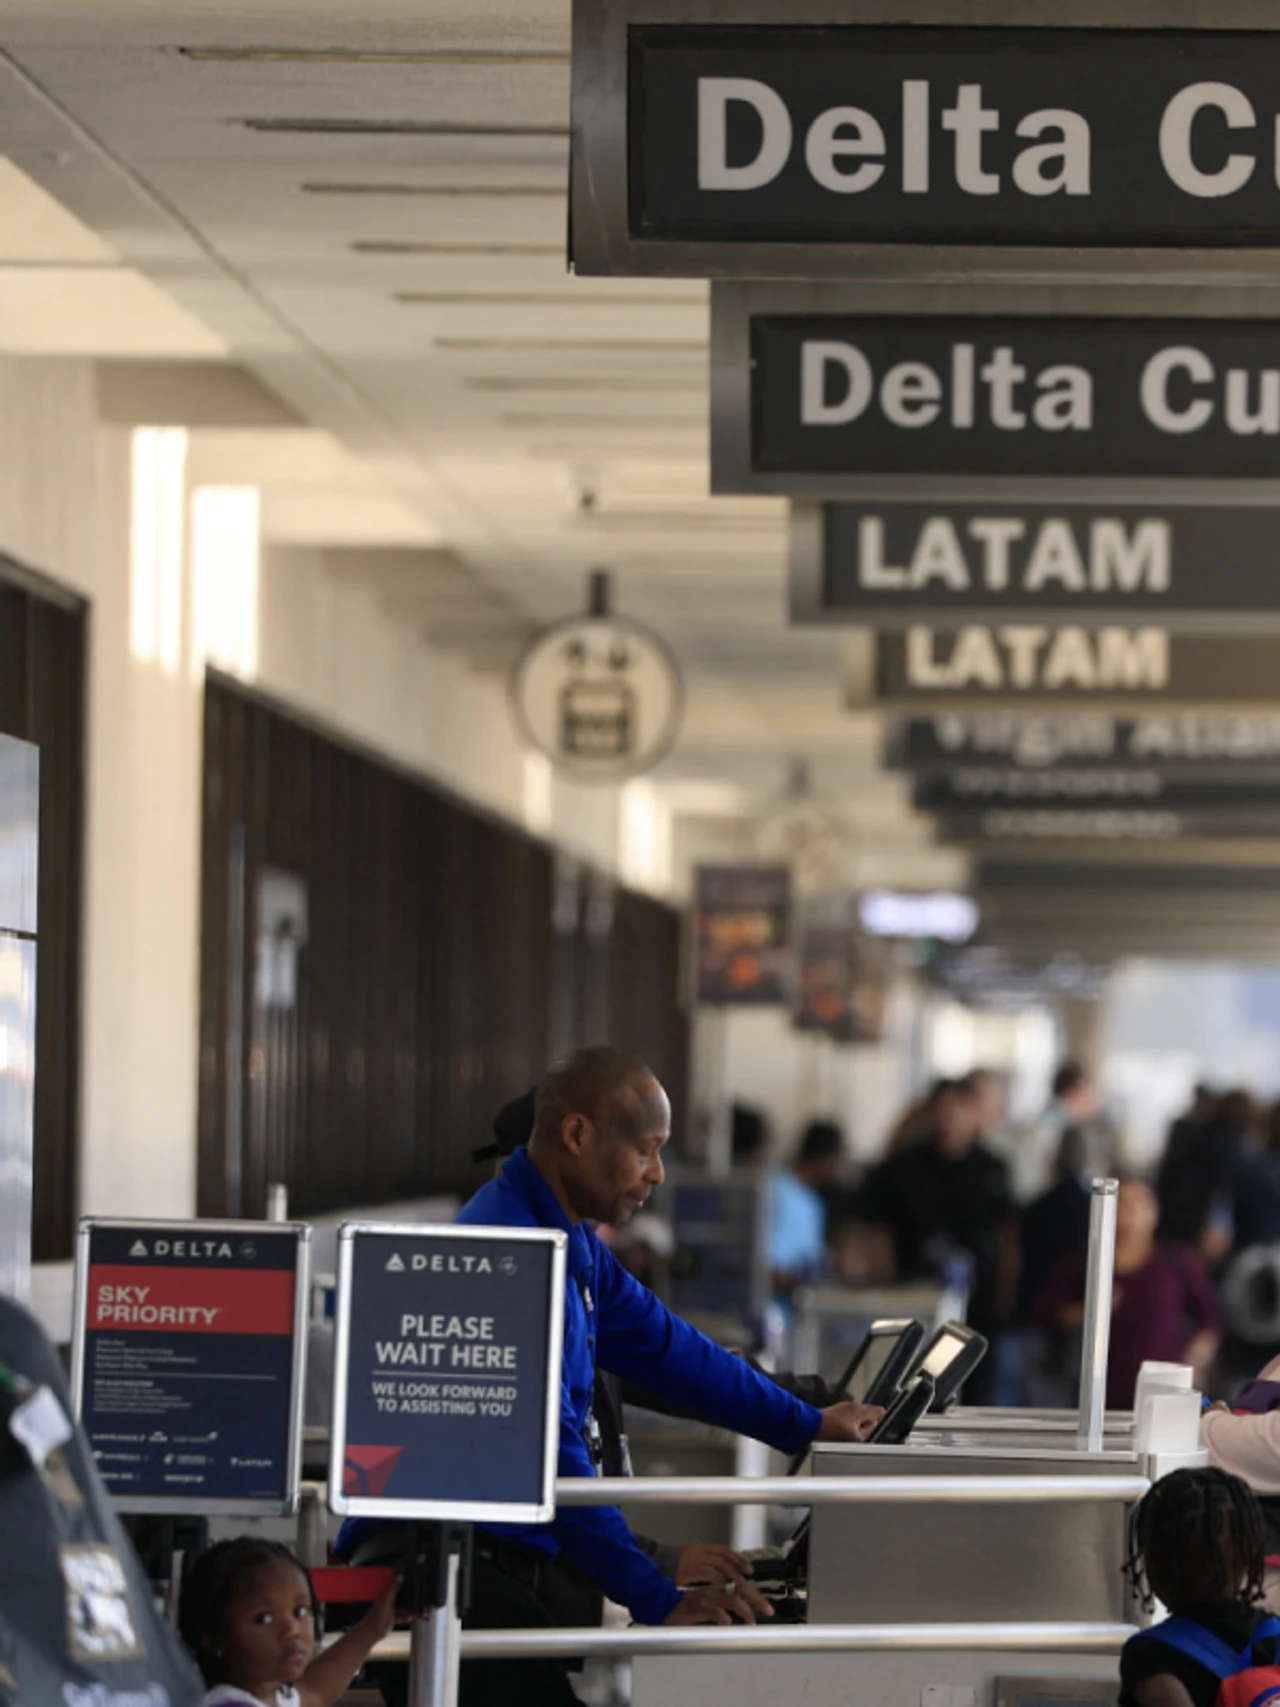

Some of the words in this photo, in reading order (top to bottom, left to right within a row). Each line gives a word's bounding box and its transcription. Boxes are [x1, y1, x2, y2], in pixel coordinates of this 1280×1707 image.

[698, 77, 1092, 195] Delta
[801, 341, 1094, 431] Delta
[858, 516, 1172, 592] LATAM
[906, 625, 1171, 690] LATAM
[154, 1240, 233, 1258] DELTA
[411, 1253, 493, 1274] DELTA
[98, 1285, 150, 1304] SKY
[96, 1304, 219, 1326] PRIORITY
[401, 1313, 495, 1341] PLEASE
[375, 1340, 447, 1367] WAIT
[451, 1344, 518, 1369] HERE
[371, 1382, 396, 1396] WE
[399, 1382, 440, 1398] LOOK
[442, 1384, 518, 1401] FORWARD
[375, 1397, 398, 1413] TO
[400, 1399, 477, 1416] ASSISTING
[479, 1402, 513, 1418] YOU
